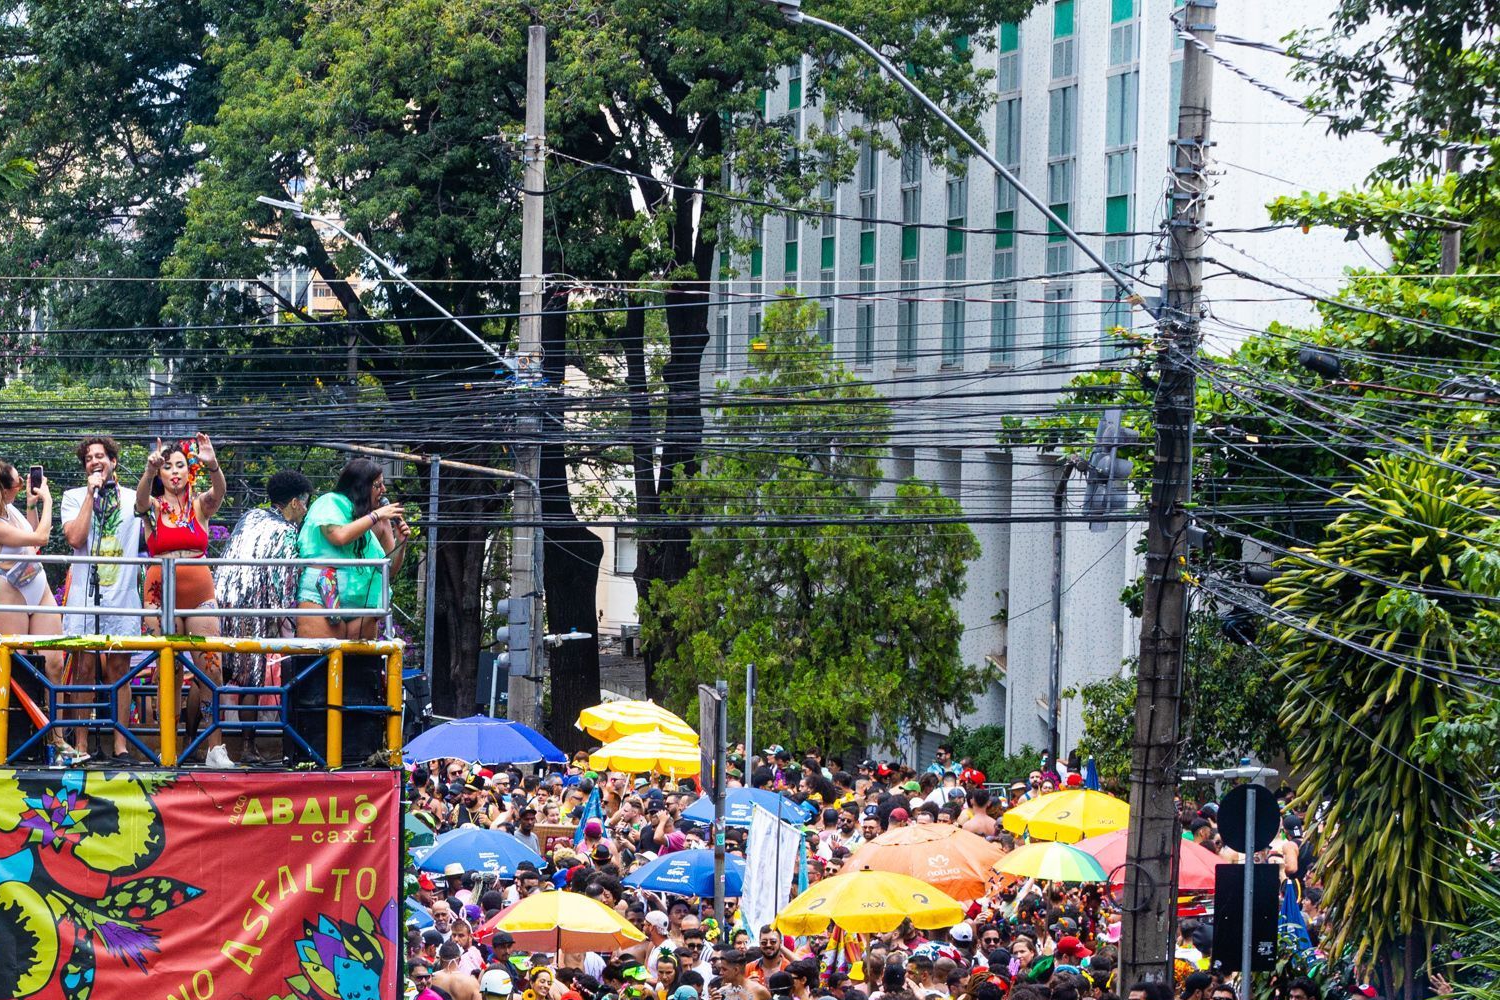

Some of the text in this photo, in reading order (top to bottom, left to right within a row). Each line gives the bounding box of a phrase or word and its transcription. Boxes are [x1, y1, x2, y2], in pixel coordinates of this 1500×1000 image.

[228, 795, 247, 825] BLOCO
[241, 794, 378, 825] ABALÔ
[221, 864, 378, 975] ASFALTO
